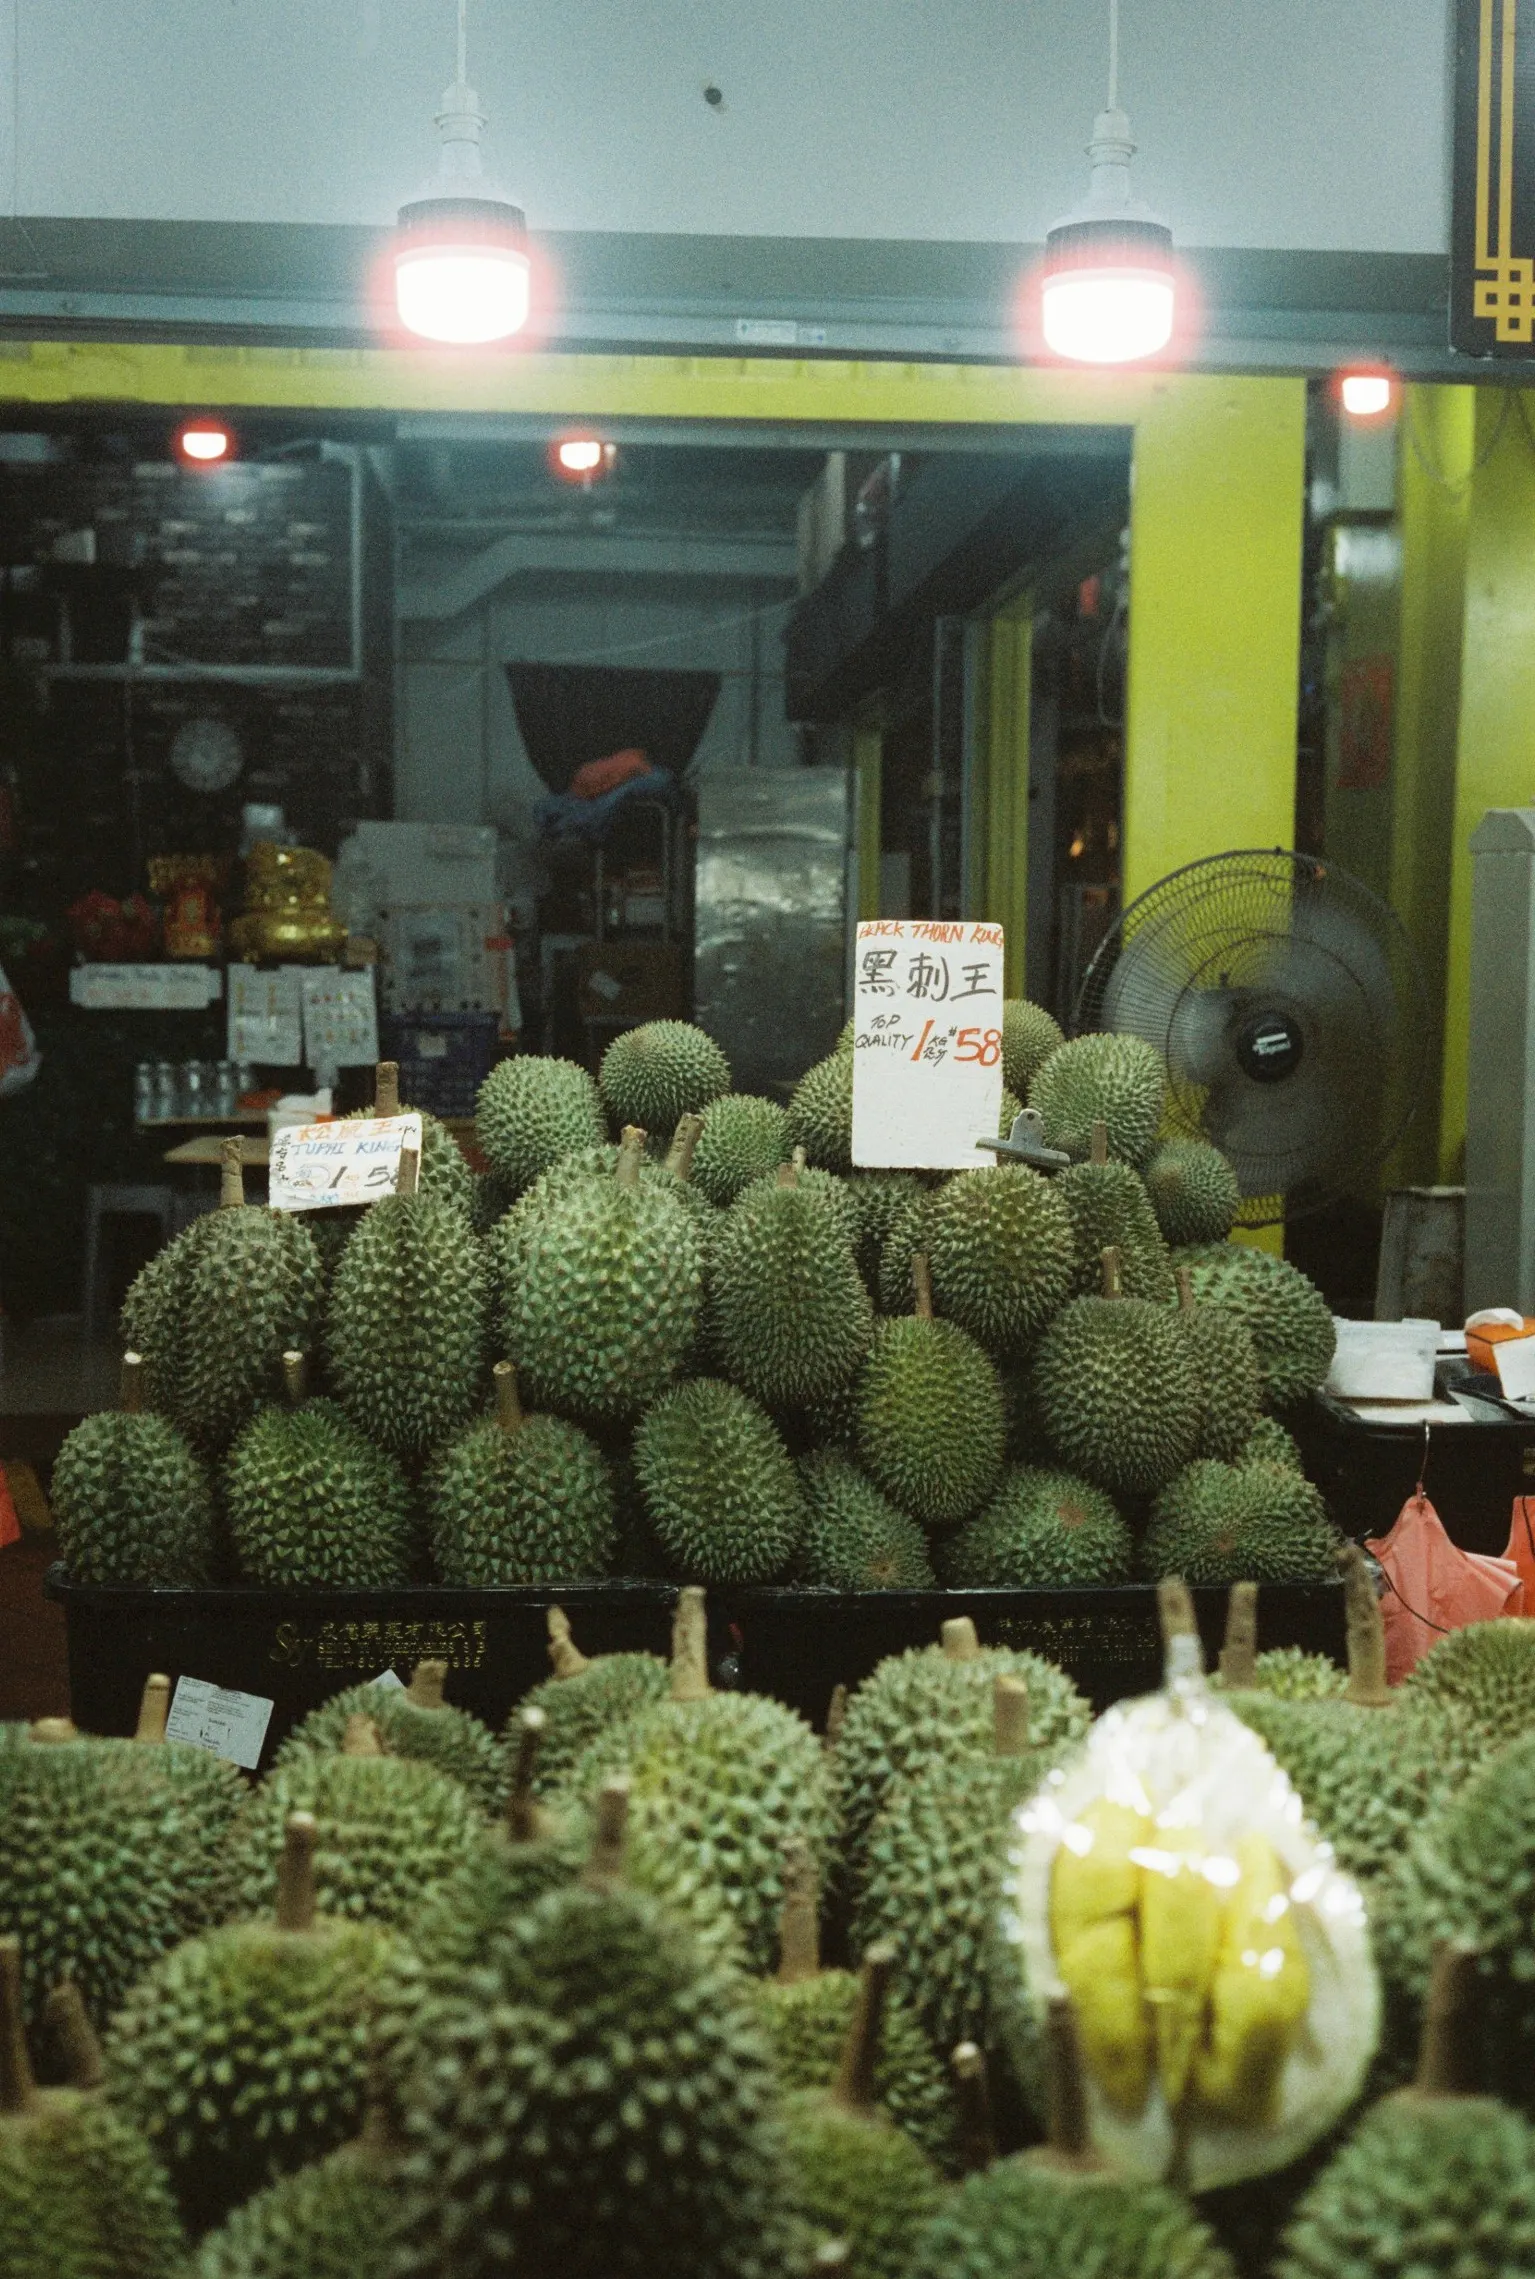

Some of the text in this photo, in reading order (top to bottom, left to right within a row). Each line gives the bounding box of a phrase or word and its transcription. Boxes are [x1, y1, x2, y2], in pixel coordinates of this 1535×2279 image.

[911, 923, 964, 944] THORN
[858, 949, 997, 1002] 黑刺王
[871, 1014, 901, 1030] TOP
[855, 1033, 914, 1051] QUALITY
